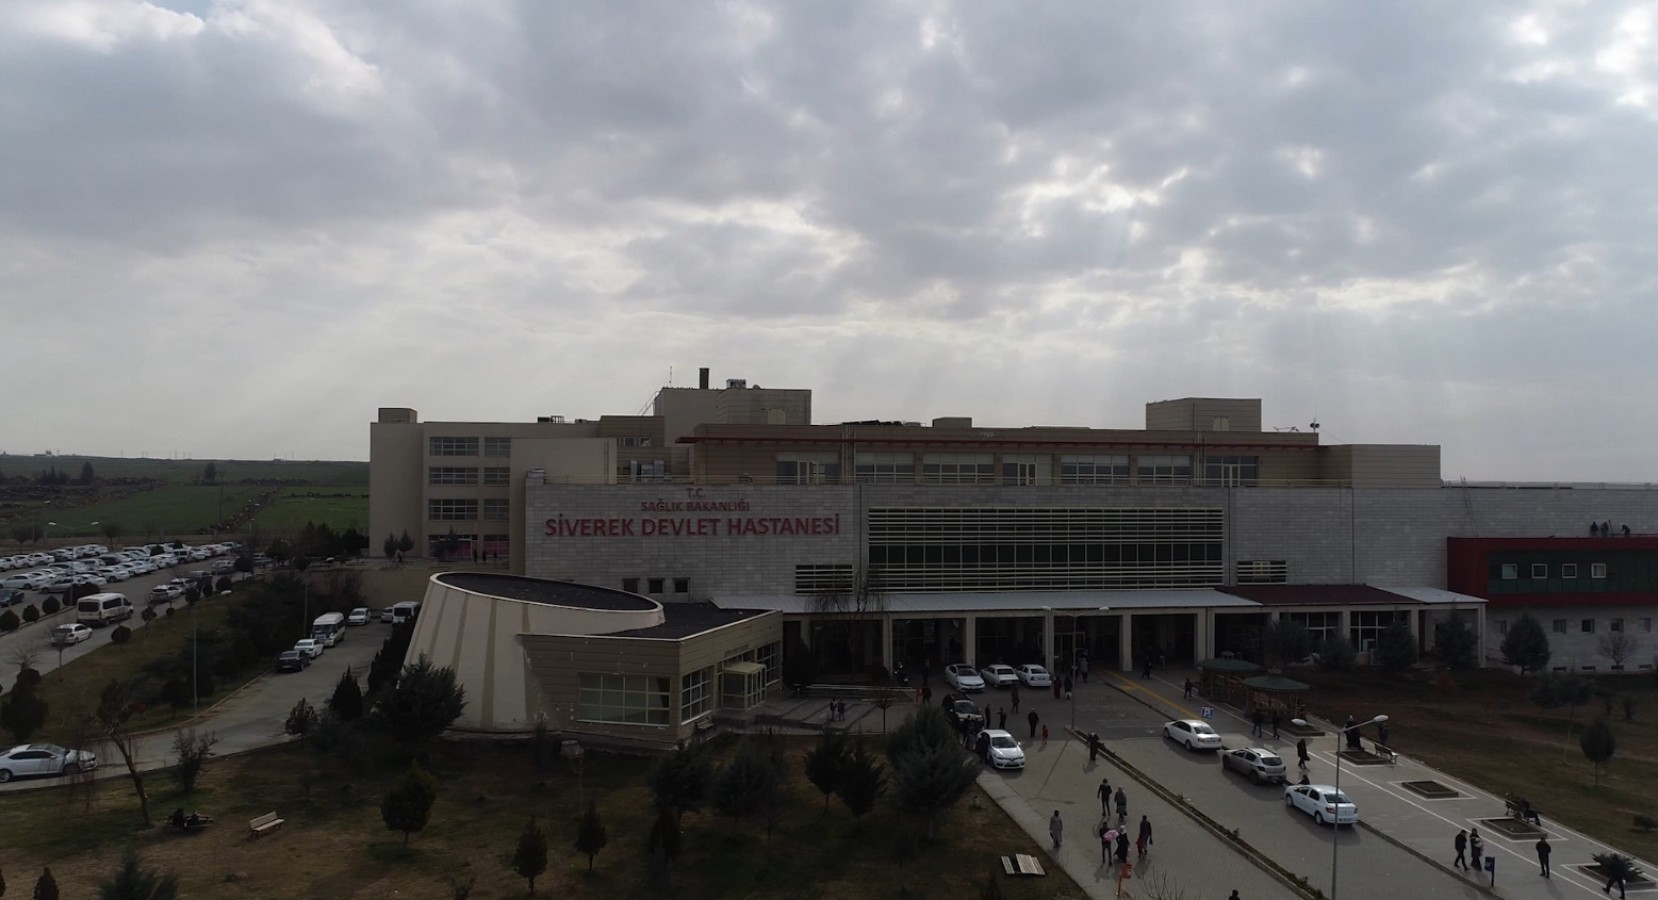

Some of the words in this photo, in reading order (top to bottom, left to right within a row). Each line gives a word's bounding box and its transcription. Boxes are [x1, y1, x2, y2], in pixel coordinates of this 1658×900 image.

[686, 488, 706, 499] T.C.
[640, 498, 683, 512] SAĞLIK
[686, 498, 750, 512] BAKANLIĞI
[544, 513, 635, 537] SİVEREK
[641, 517, 721, 536] DEVLET
[727, 513, 840, 536] HASTANESİ
